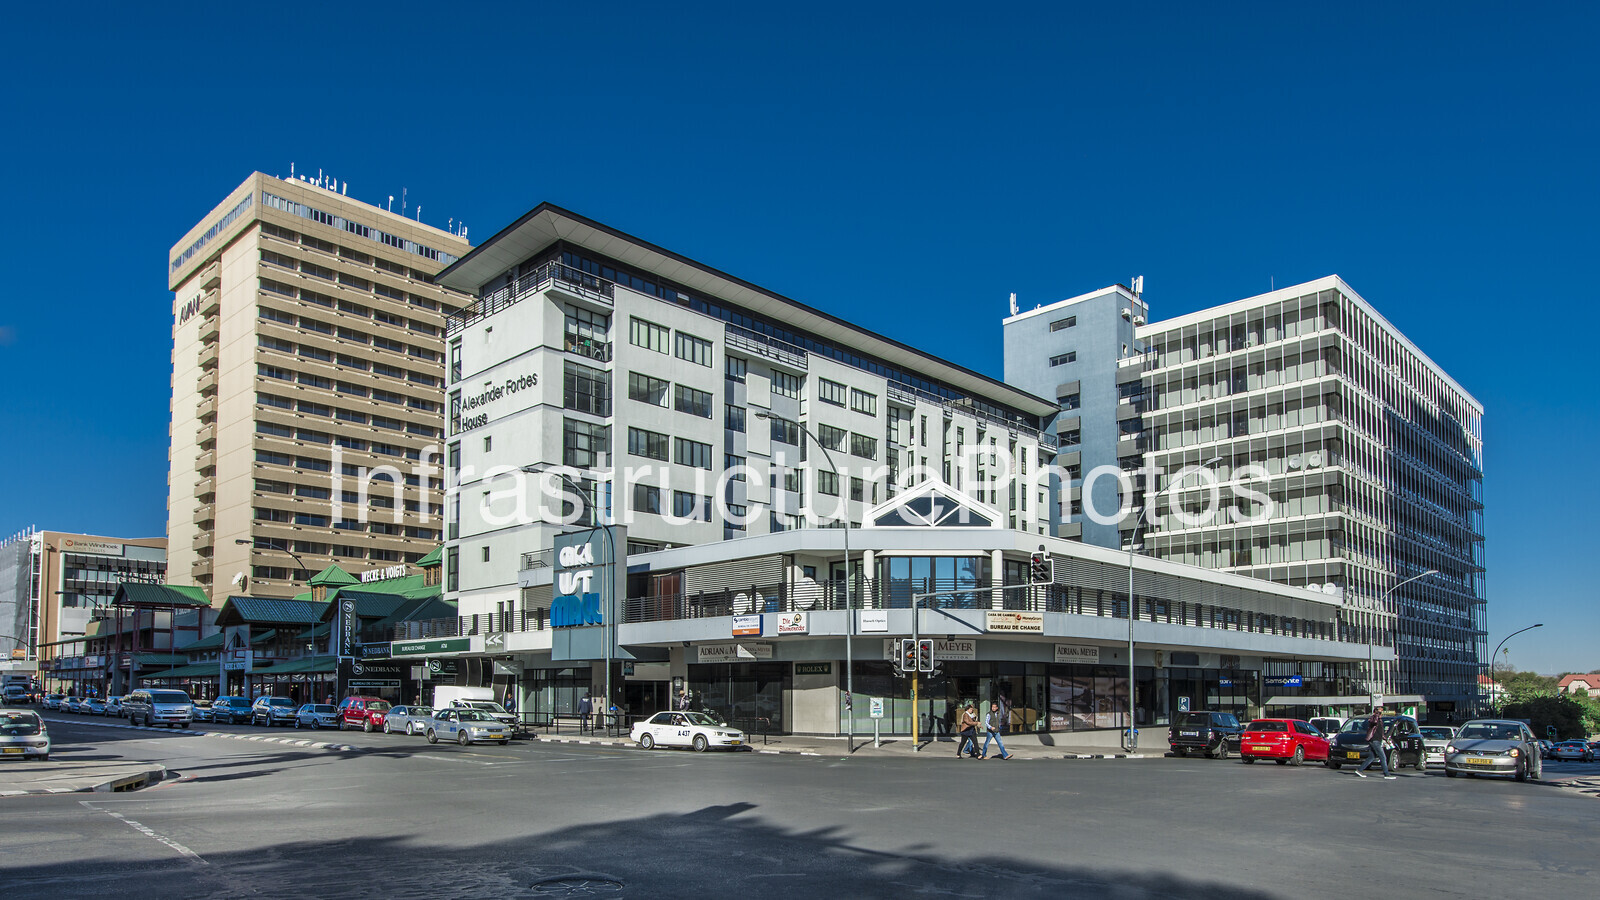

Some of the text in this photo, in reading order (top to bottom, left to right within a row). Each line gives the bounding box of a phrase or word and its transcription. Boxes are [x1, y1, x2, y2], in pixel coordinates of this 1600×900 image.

[462, 372, 538, 412] Alexander Forbes
[462, 412, 488, 432] House
[361, 564, 406, 582] WECKE & VOIGTS
[368, 646, 392, 655] NEDBANK
[700, 647, 725, 655] ADRIAN
[938, 642, 973, 652] MEYER
[1057, 646, 1077, 655] ADRIAN
[1080, 647, 1097, 656] MEYER
